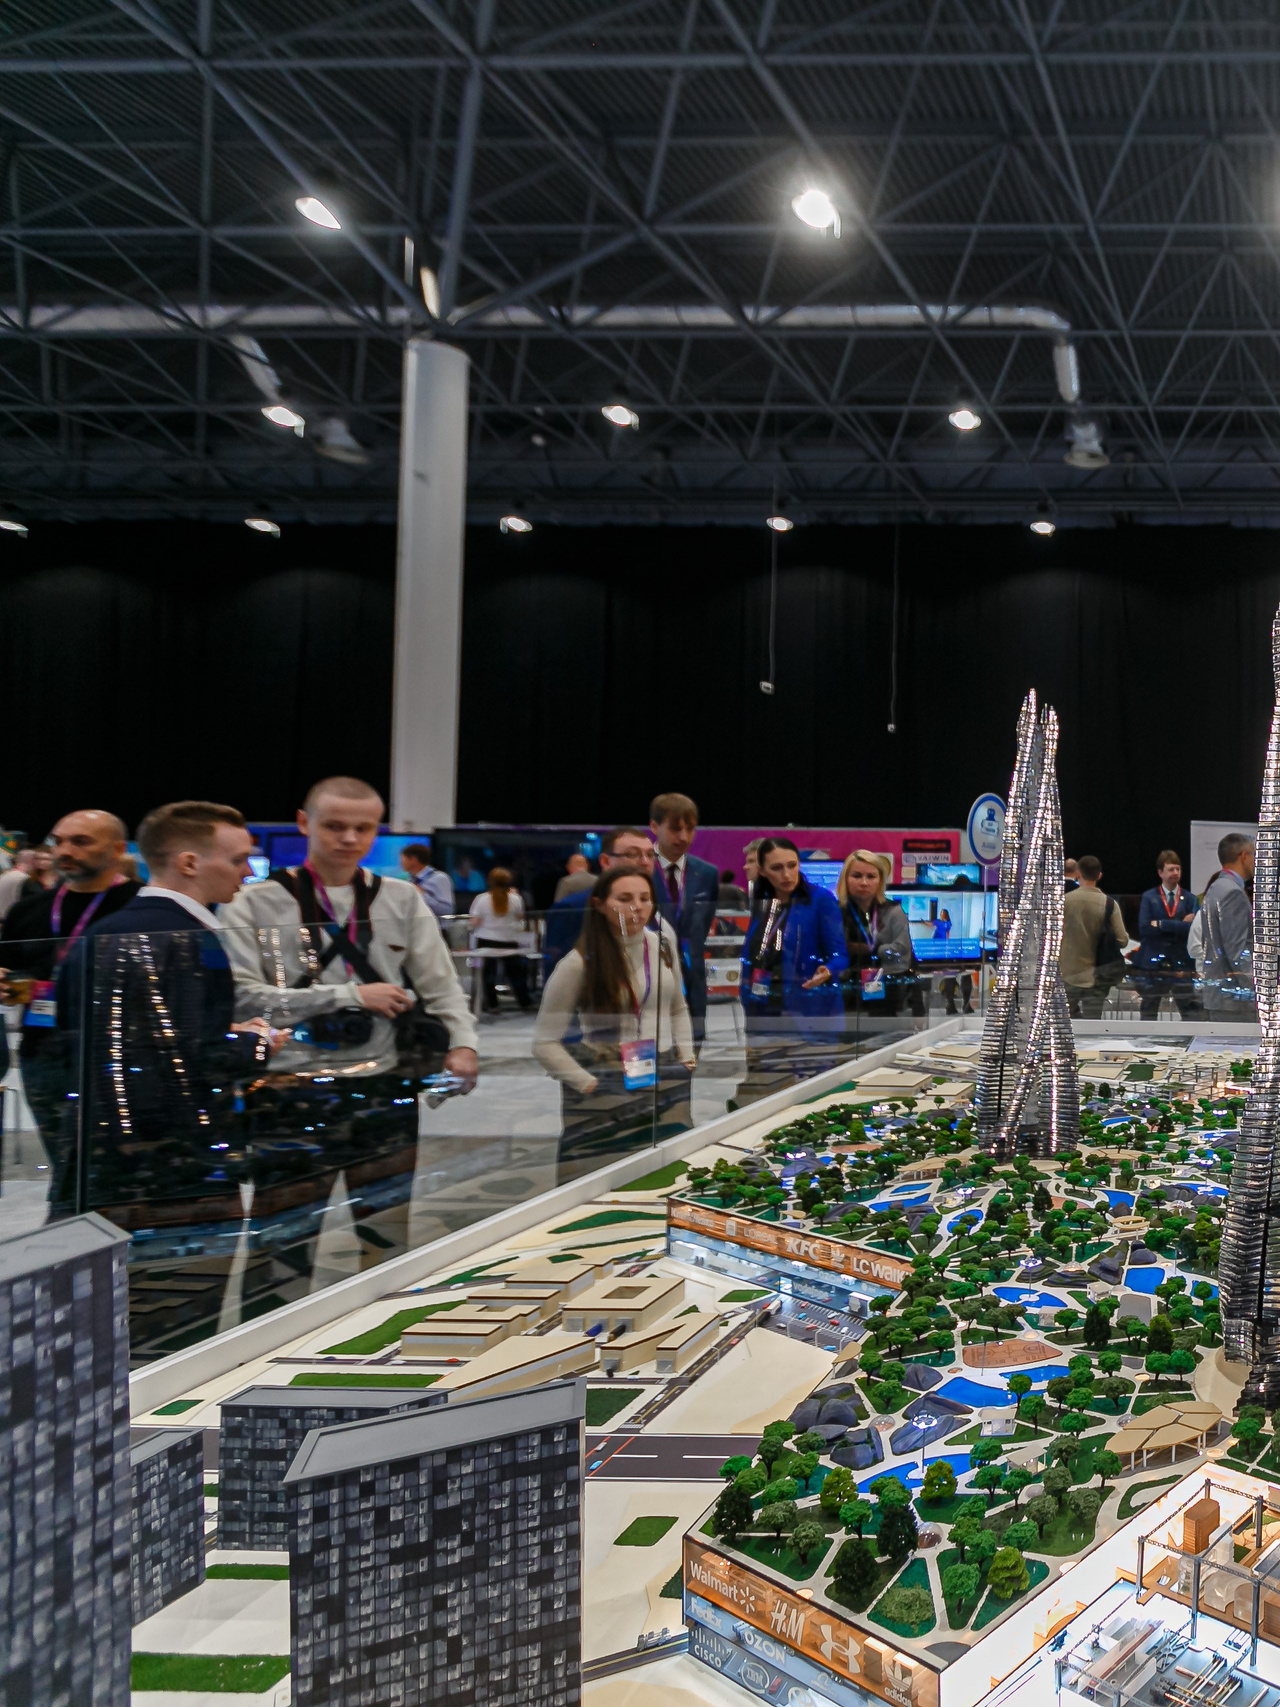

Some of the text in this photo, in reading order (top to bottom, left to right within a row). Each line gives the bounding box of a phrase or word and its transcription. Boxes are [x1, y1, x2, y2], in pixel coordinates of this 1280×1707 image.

[786, 1236, 821, 1261] KFC
[690, 1560, 739, 1603] Walmart
[770, 1599, 805, 1647] H&M
[744, 1630, 786, 1664] OZON
[884, 1686, 912, 1707] adidas
